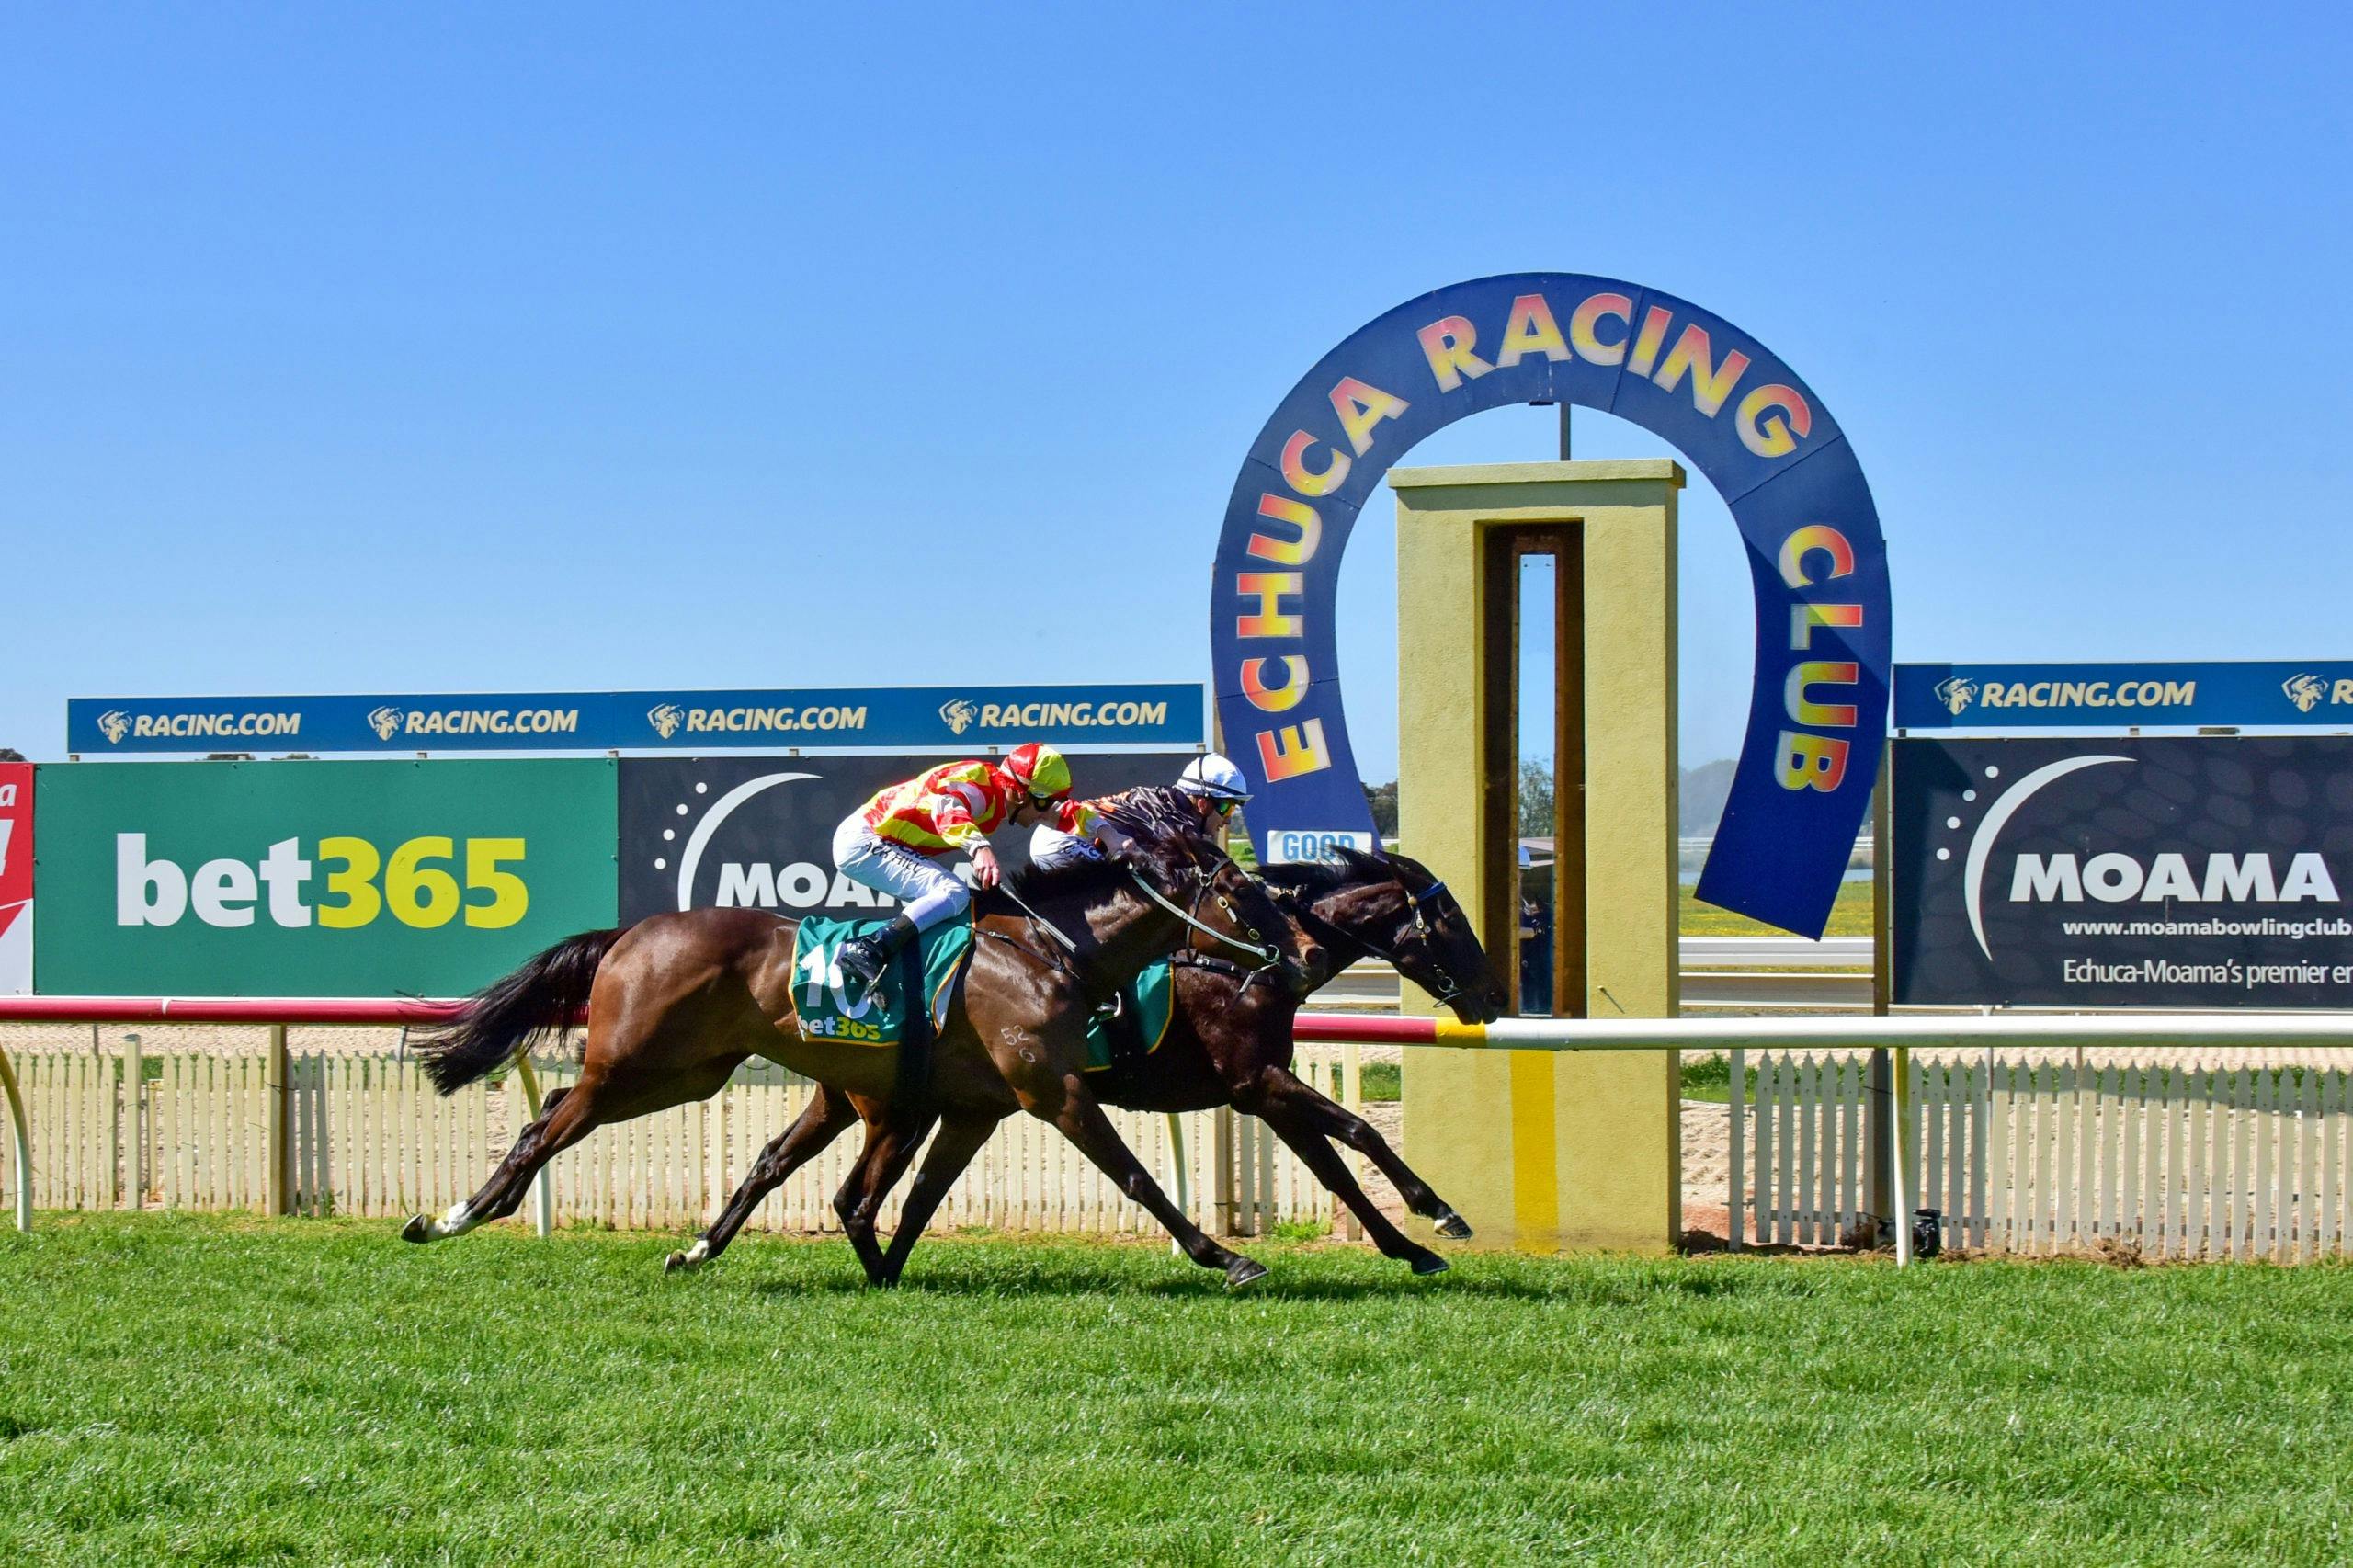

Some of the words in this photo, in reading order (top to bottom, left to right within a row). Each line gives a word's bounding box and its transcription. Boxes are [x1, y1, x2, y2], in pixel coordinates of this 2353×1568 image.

[1237, 376, 1410, 783] ECHUCA
[1416, 293, 1812, 458] RACING
[1773, 525, 1862, 792] CLUB
[1981, 681, 2196, 707] RACING.COM
[134, 712, 301, 737] RACING.COM
[404, 710, 577, 734] RACING.COM
[687, 706, 867, 732] RACING.COM
[979, 702, 1167, 727] RACING.COM
[117, 833, 529, 929] bet365
[716, 862, 981, 907] MOA
[2009, 853, 2341, 902] MOAMA
[2246, 959, 2329, 989] premier
